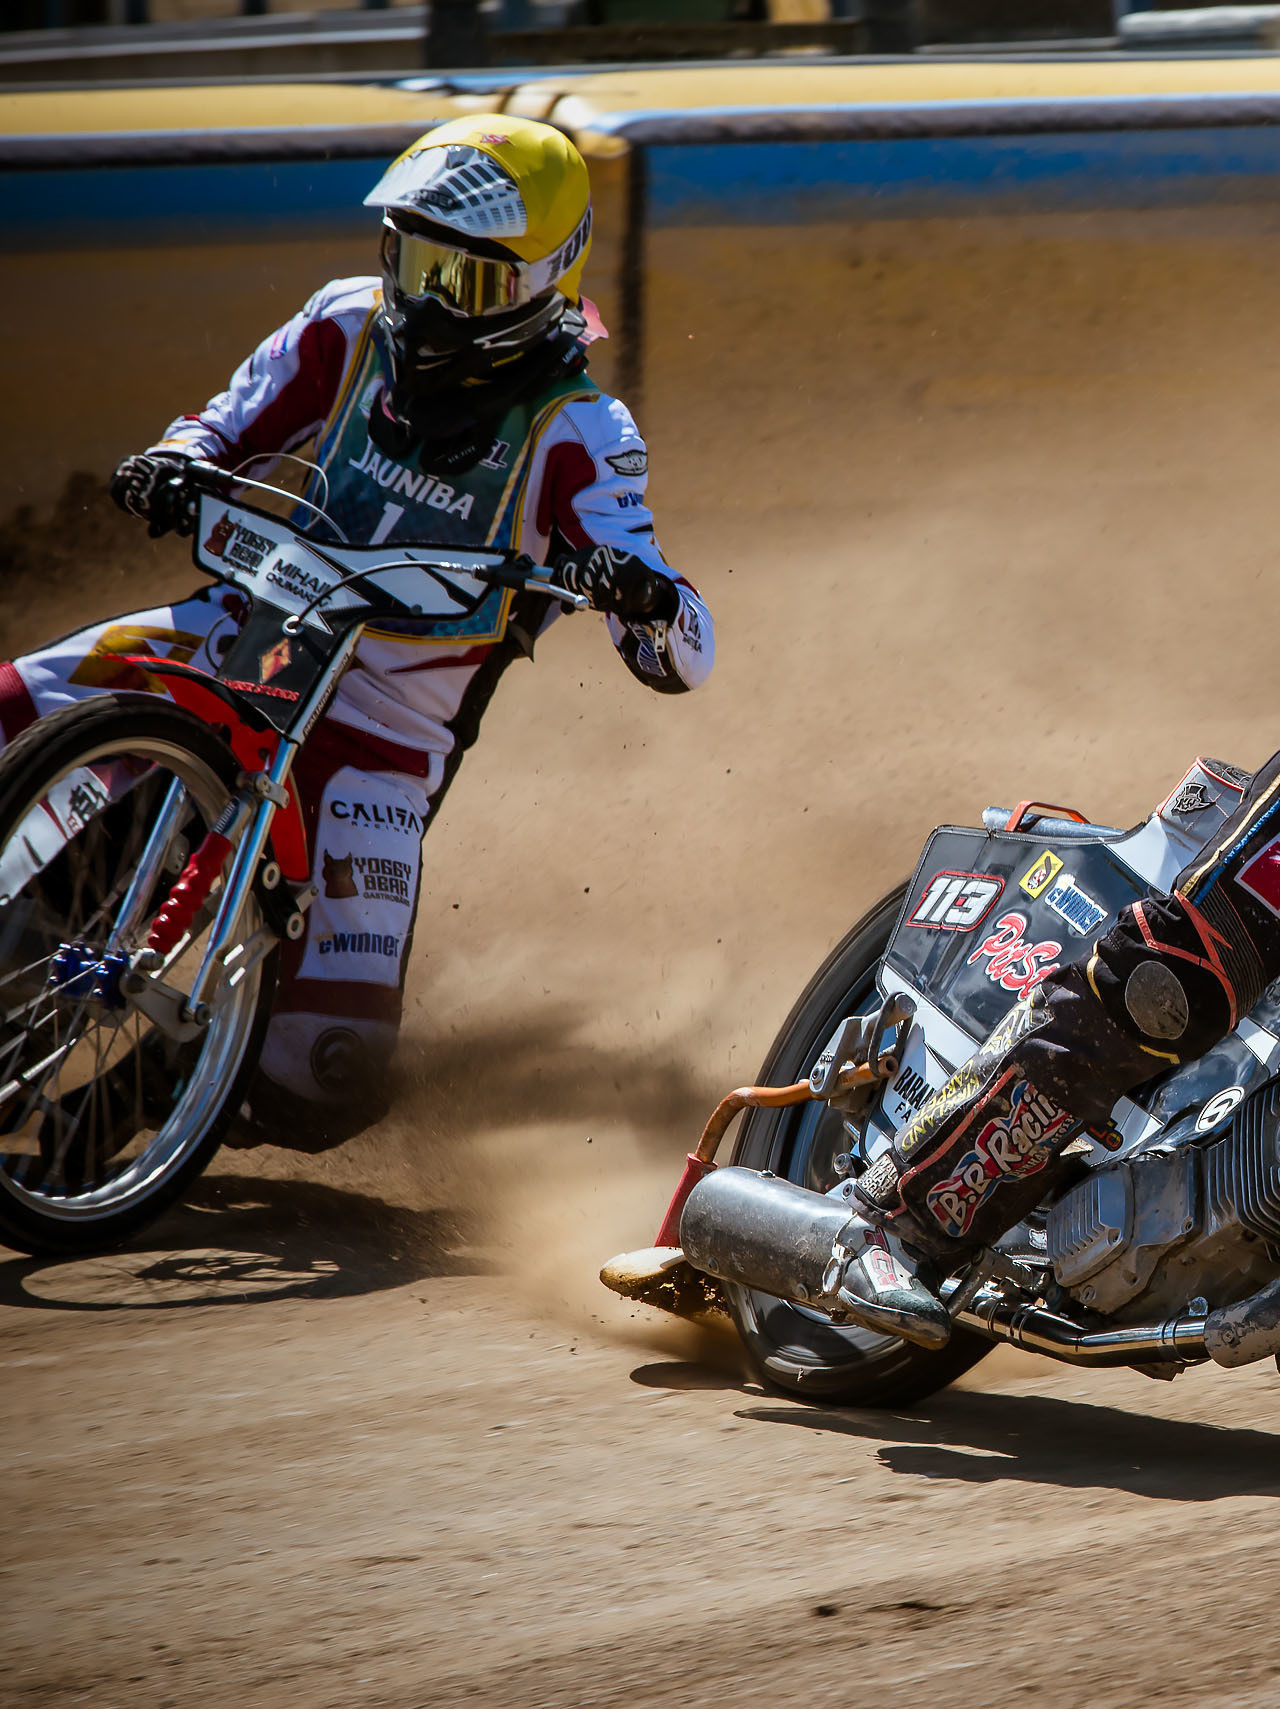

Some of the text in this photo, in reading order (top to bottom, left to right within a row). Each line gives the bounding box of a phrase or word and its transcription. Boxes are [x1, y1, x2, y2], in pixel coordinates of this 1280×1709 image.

[355, 857, 412, 882] YOGGY
[364, 875, 409, 898] BEAR
[912, 876, 1001, 928] 113
